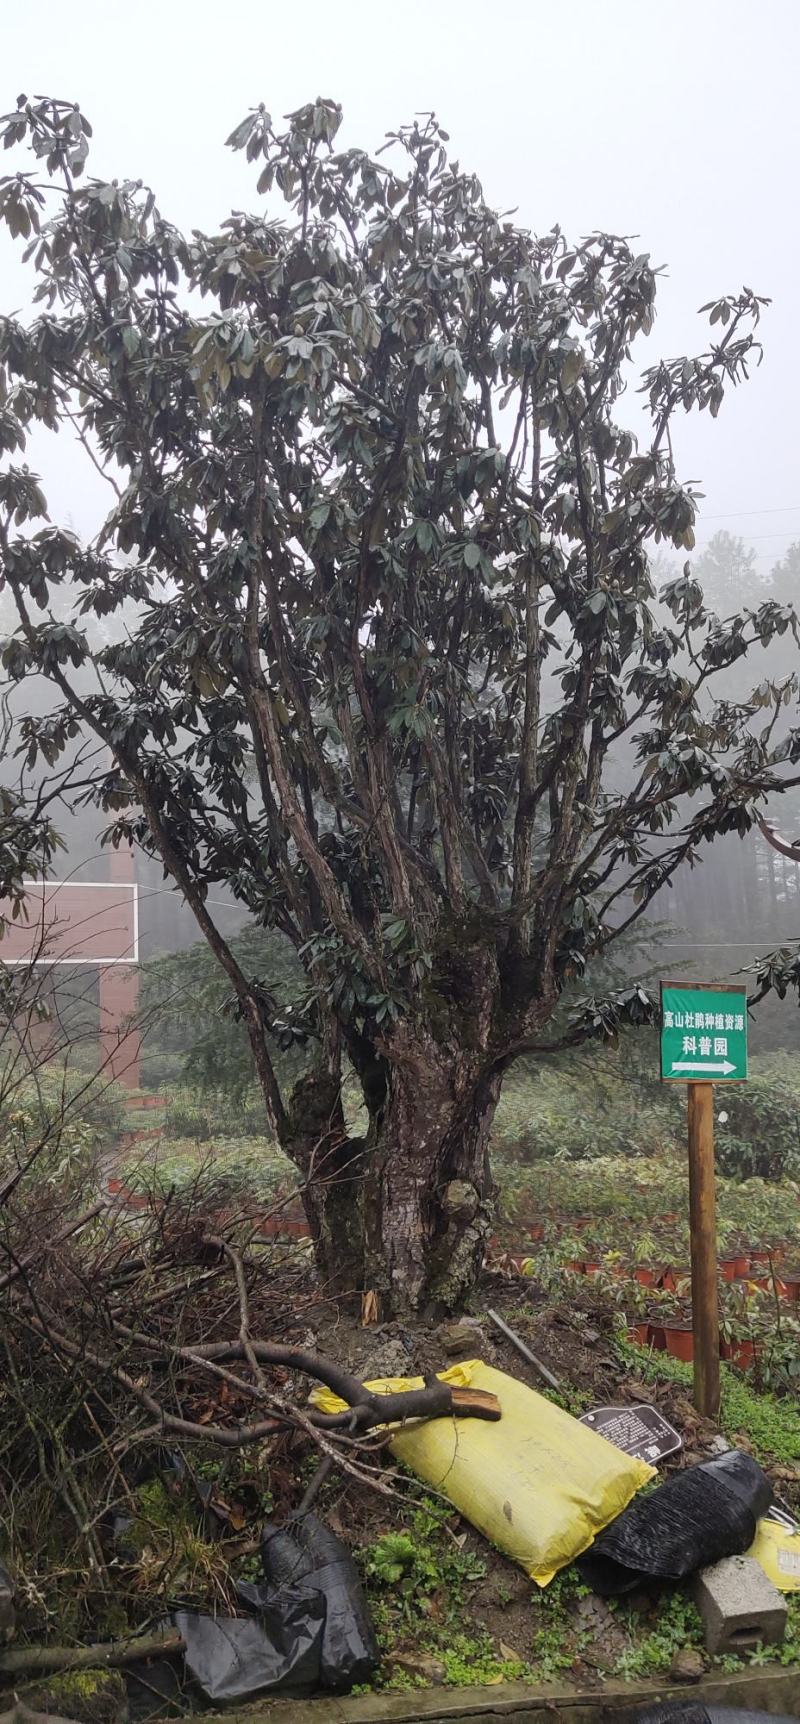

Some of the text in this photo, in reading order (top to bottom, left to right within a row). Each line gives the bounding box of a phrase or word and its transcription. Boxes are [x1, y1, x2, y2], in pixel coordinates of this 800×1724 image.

[664, 1011, 744, 1031] 高山杜鹃种植资源
[682, 1036, 728, 1056] 科普园
